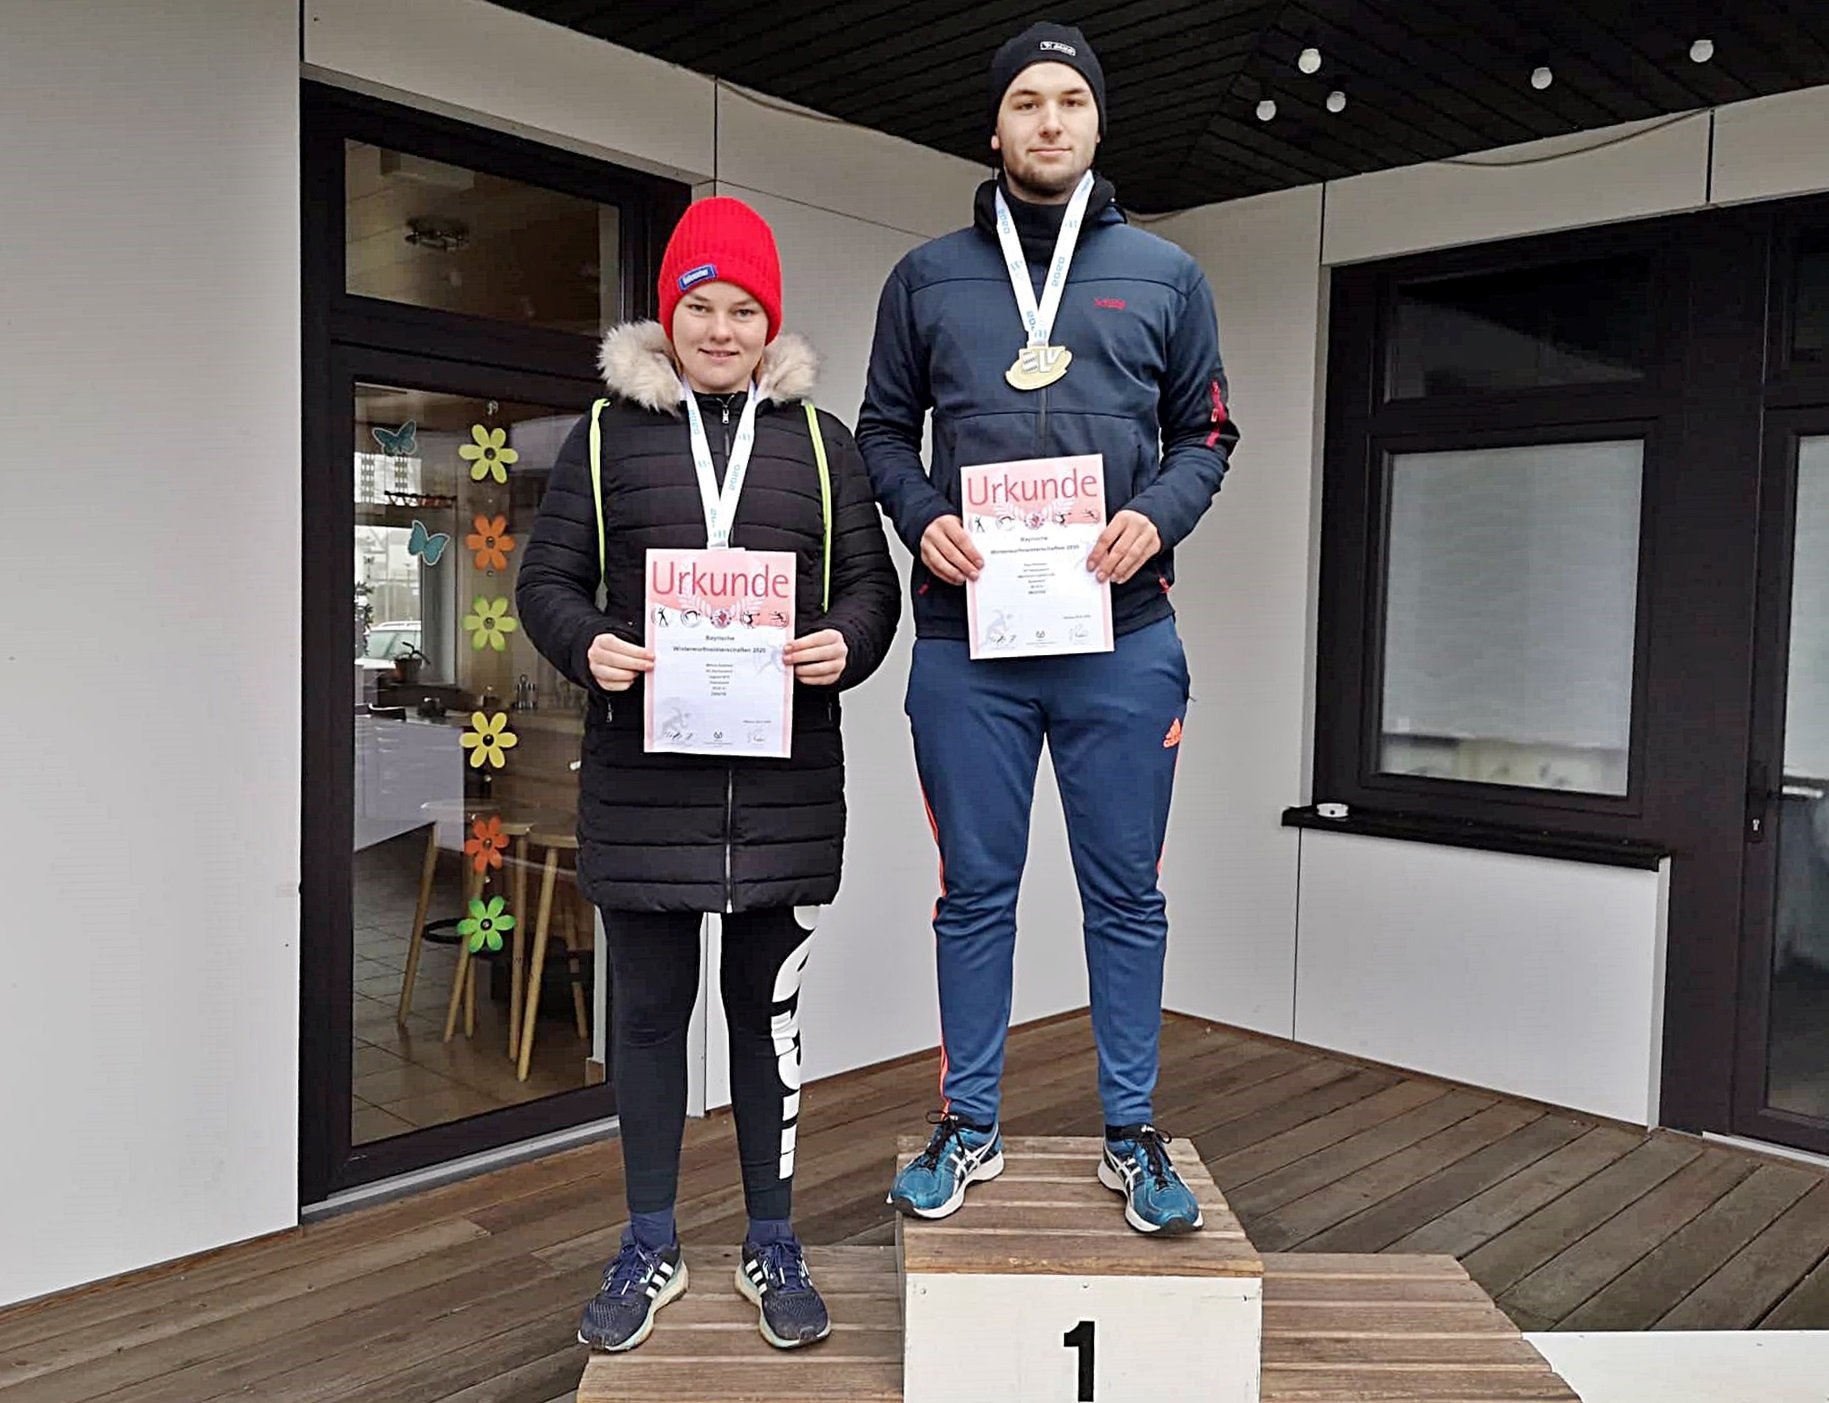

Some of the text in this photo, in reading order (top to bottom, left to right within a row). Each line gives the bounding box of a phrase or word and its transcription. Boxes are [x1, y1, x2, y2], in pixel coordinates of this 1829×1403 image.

[967, 467, 1098, 506] Urkunde
[652, 561, 789, 598] Urkunde
[1063, 1320, 1095, 1402] 1
